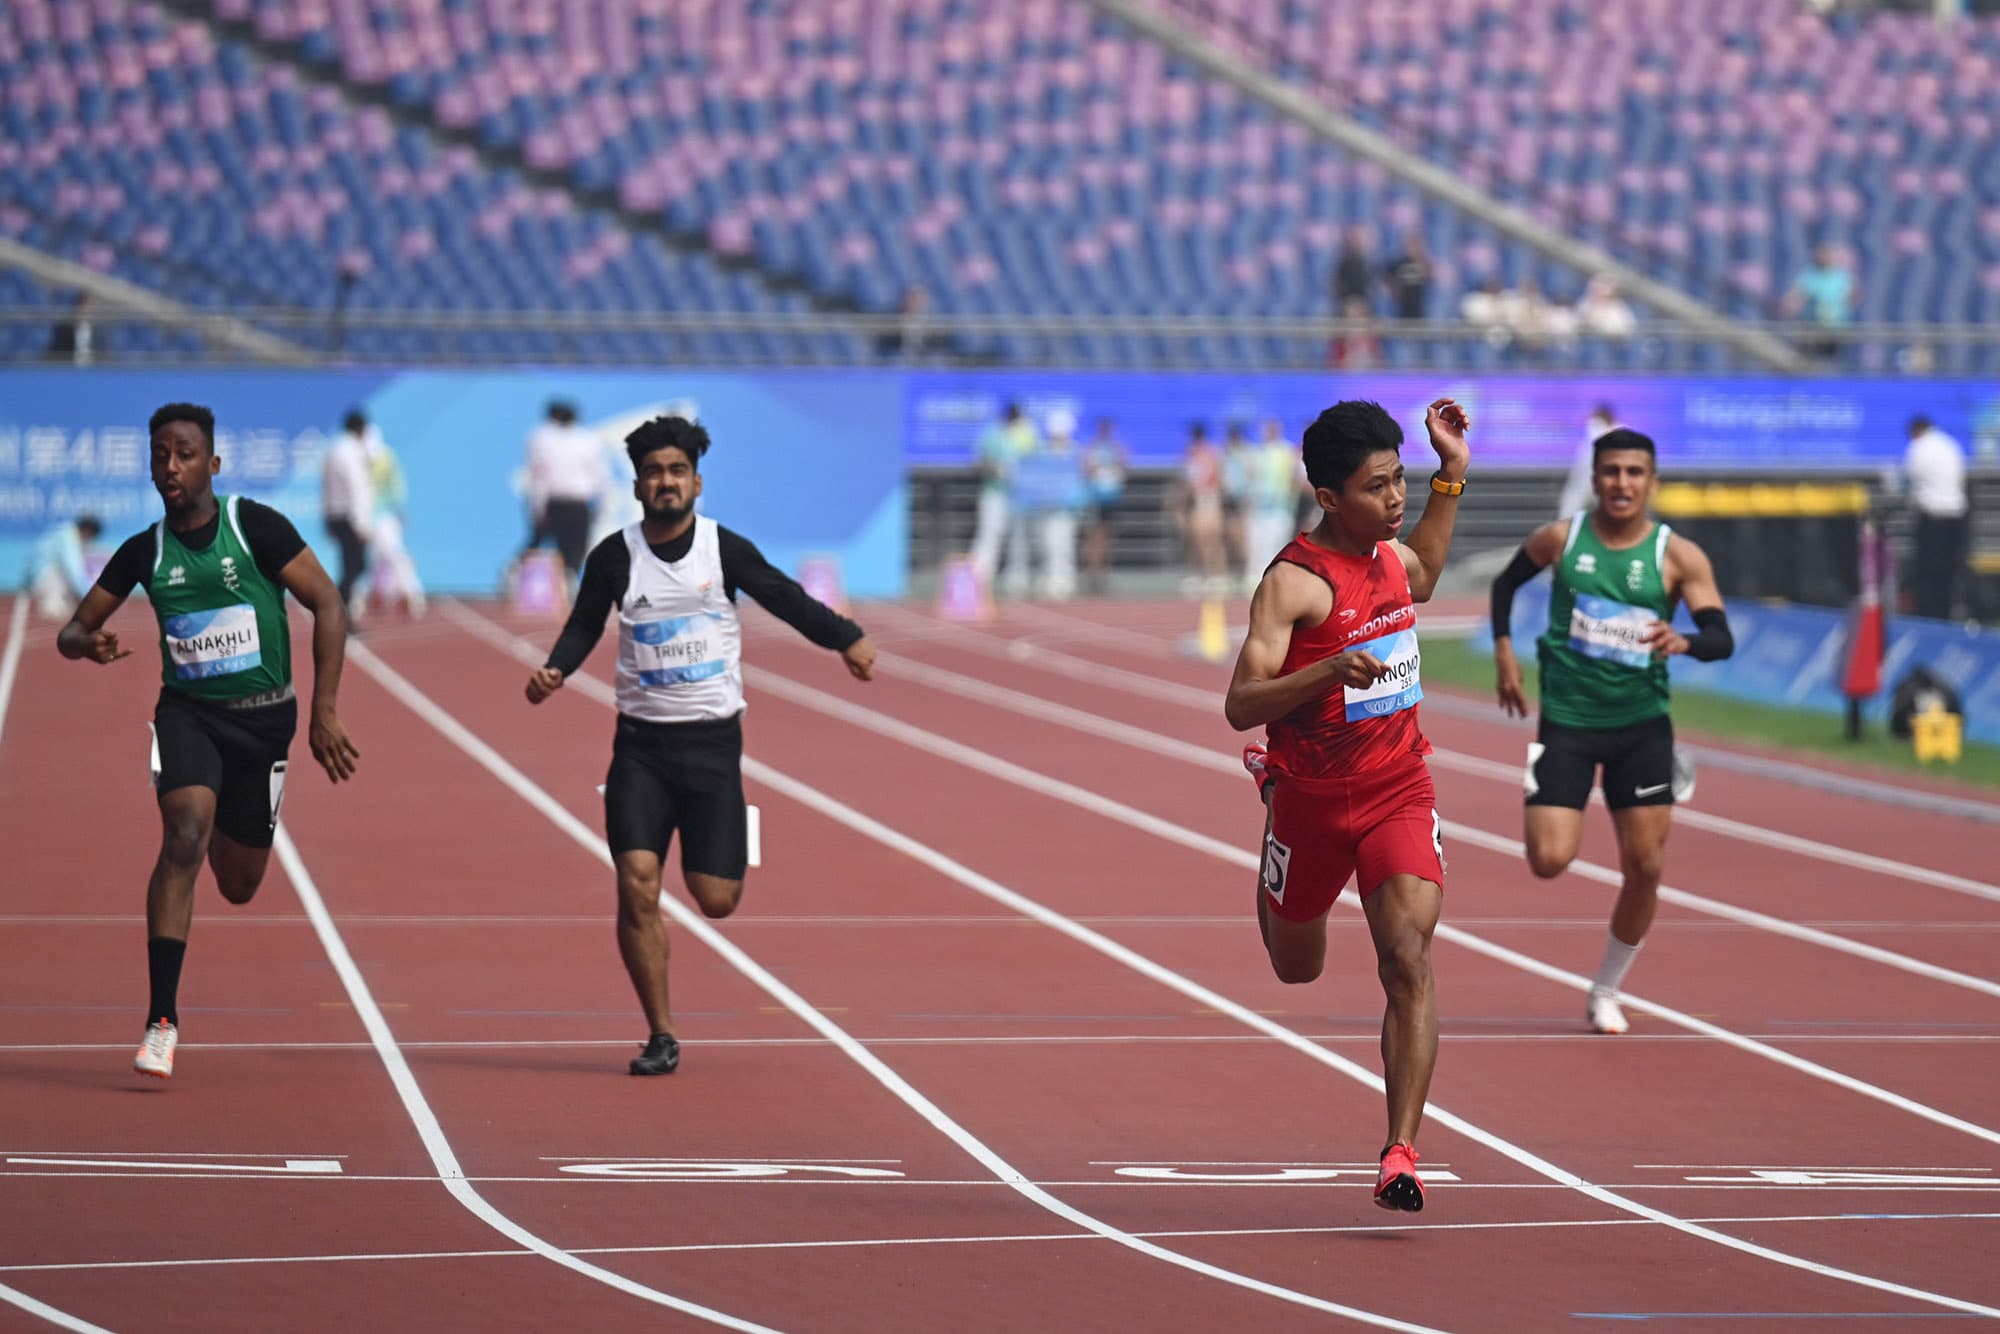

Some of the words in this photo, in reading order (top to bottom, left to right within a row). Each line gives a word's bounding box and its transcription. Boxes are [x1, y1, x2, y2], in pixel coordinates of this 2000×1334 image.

[176, 629, 252, 654] ALNAKHLI
[653, 639, 708, 658] TRIVEDI
[1267, 839, 1286, 892] 5
